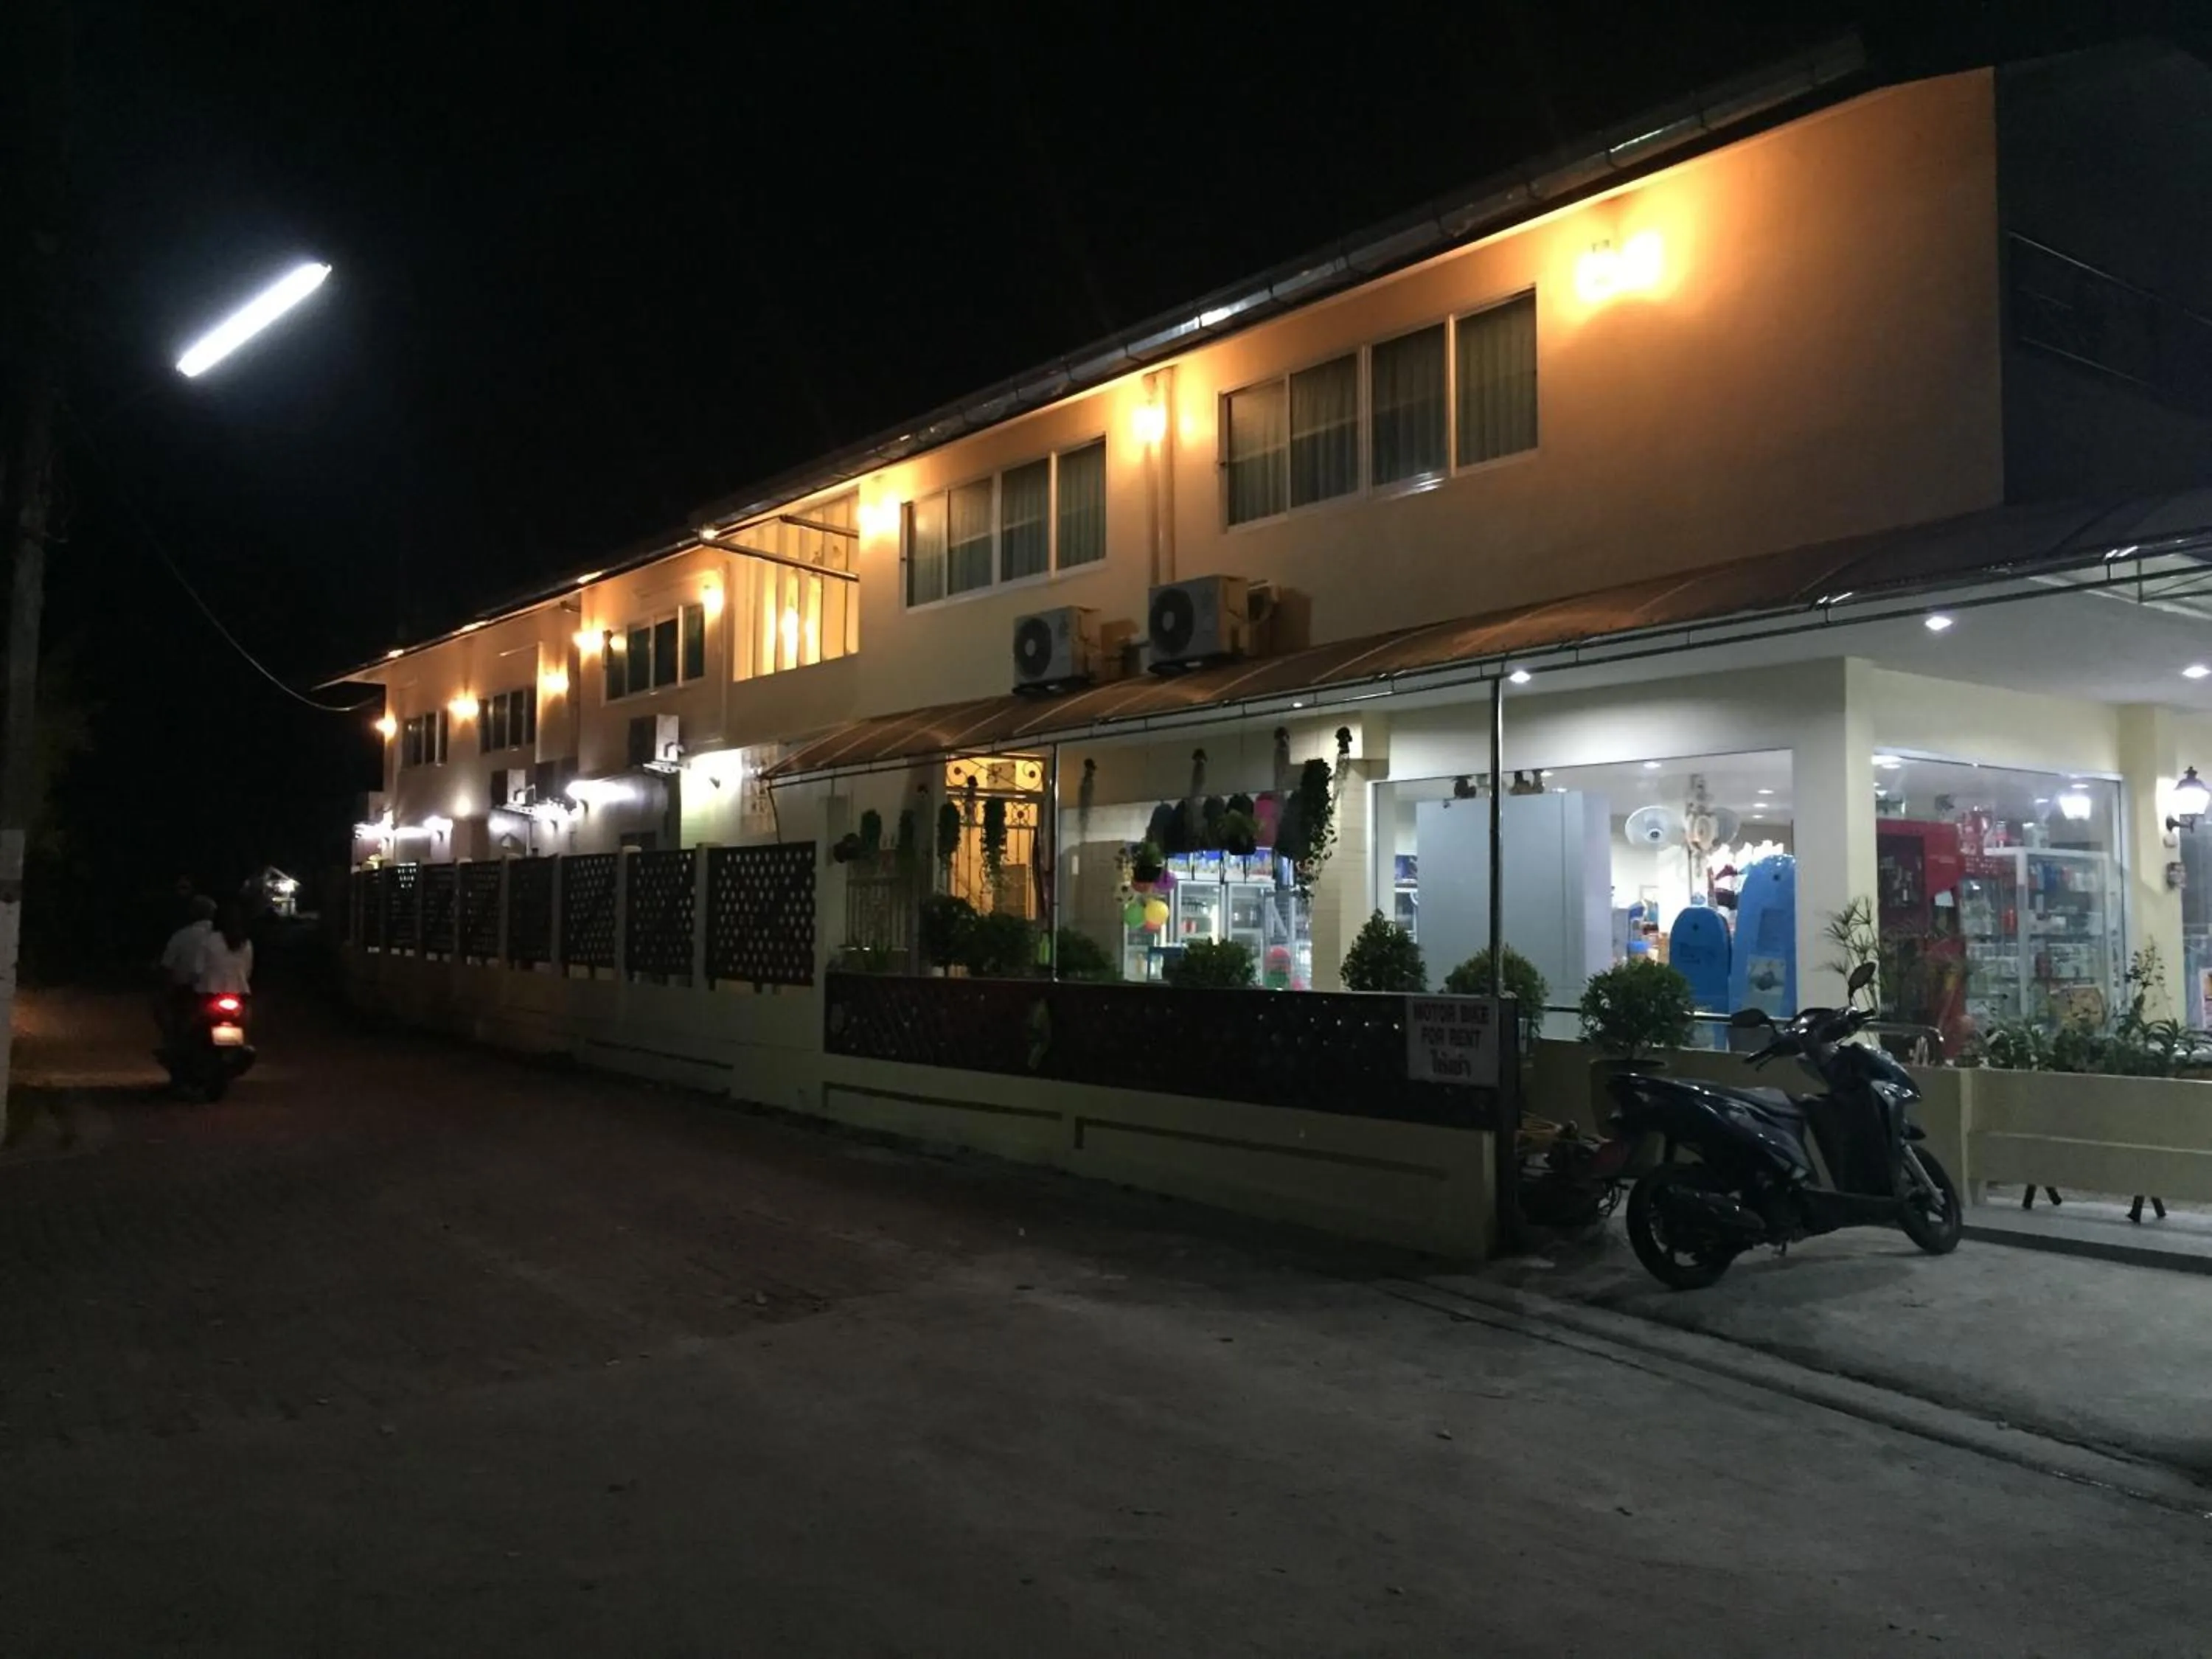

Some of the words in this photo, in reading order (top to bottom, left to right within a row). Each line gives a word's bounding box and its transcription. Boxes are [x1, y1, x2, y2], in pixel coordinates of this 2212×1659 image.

[1414, 1003, 1455, 1023] MOTOR
[1460, 1004, 1489, 1024] BIKE
[1421, 1026, 1444, 1046] FOR
[1449, 1027, 1482, 1049] RENT
